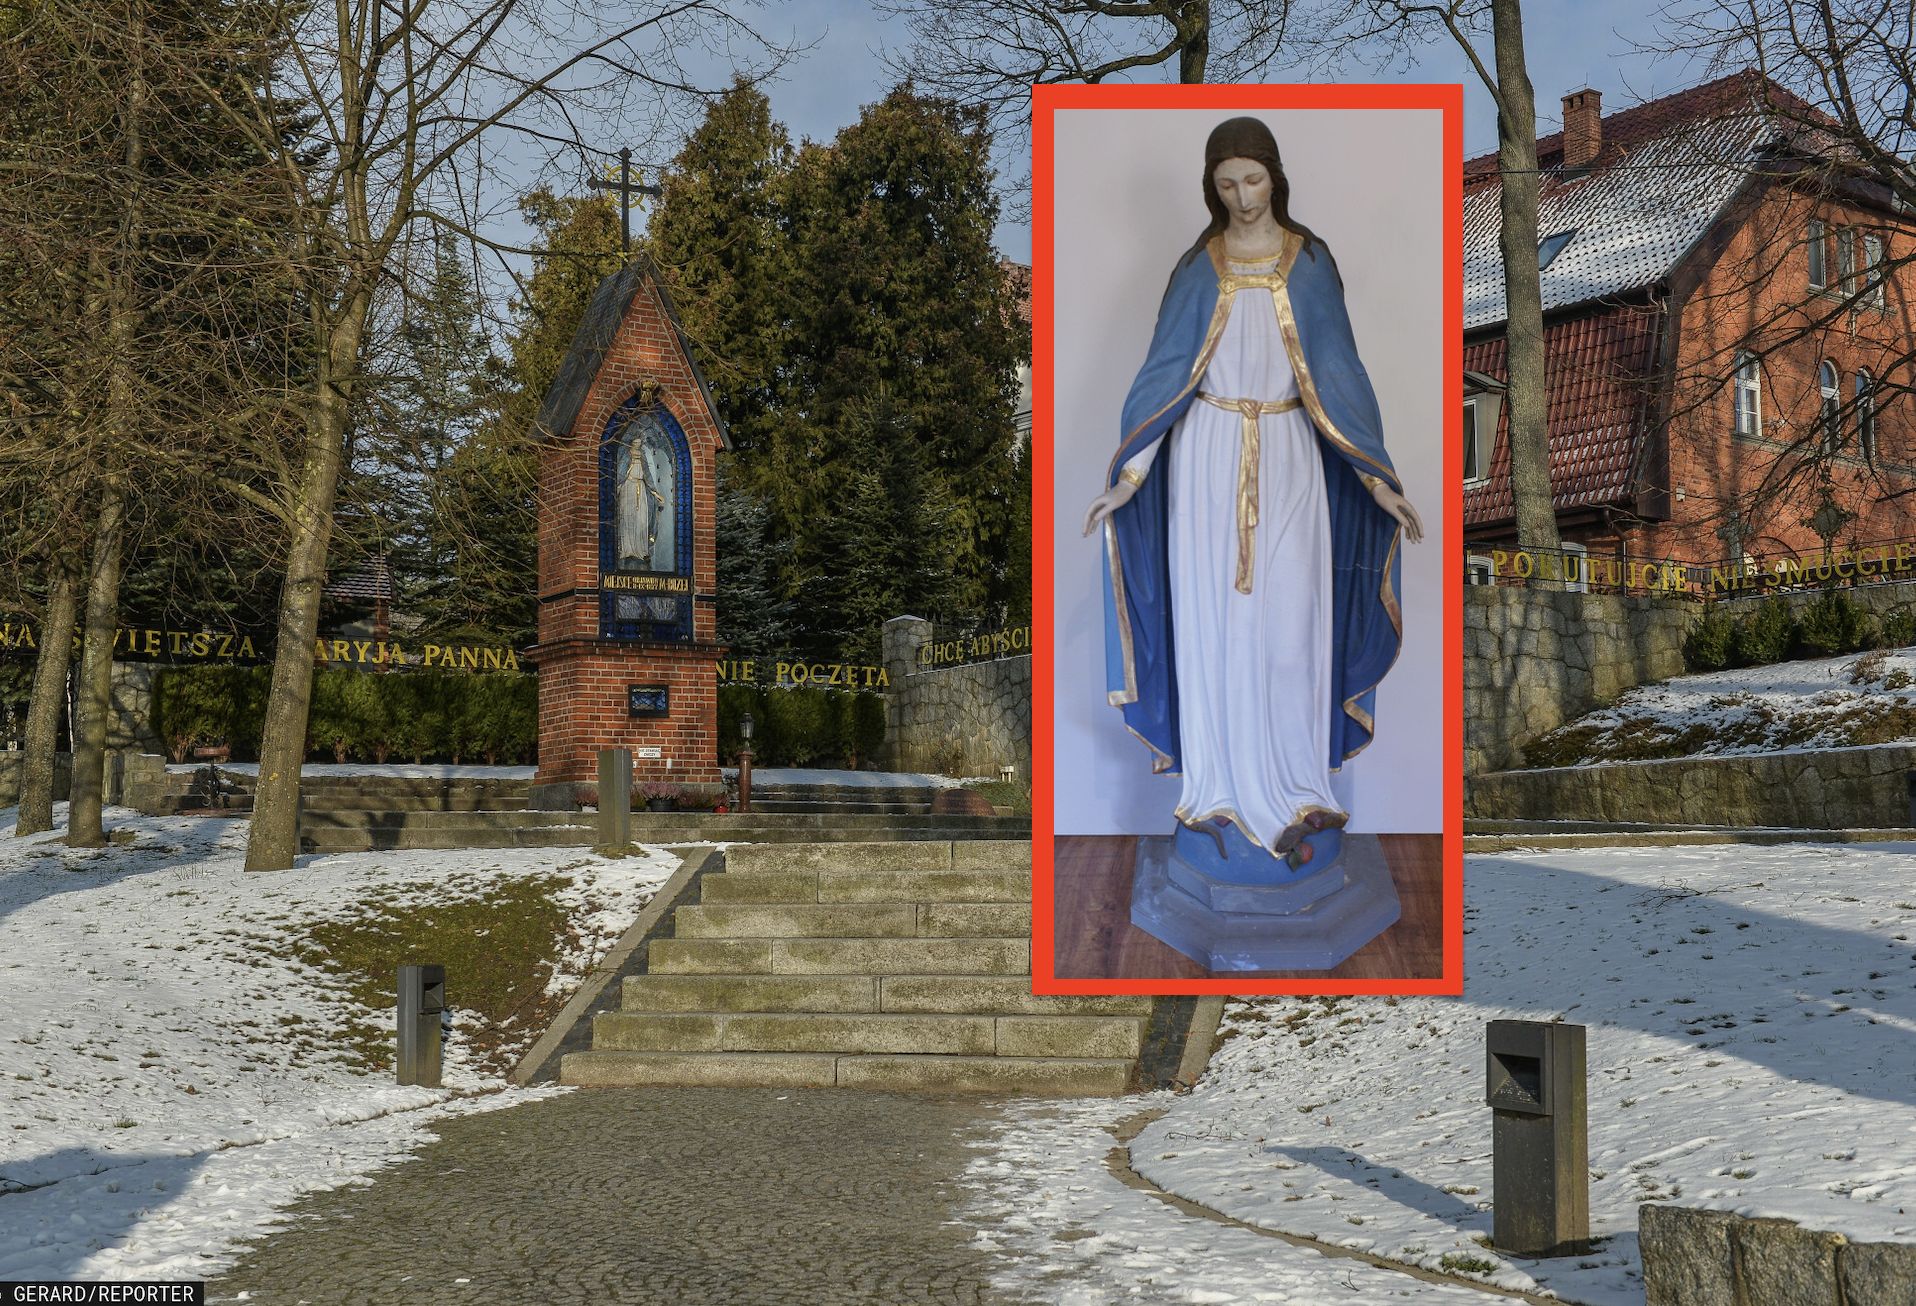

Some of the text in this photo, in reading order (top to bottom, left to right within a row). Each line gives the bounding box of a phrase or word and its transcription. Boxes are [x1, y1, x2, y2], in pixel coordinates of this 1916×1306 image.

[313, 639, 408, 665] ARYJA
[423, 644, 519, 670] PANNA
[971, 626, 1032, 657] ABYŚCI
[776, 661, 890, 688] POCZĘTA
